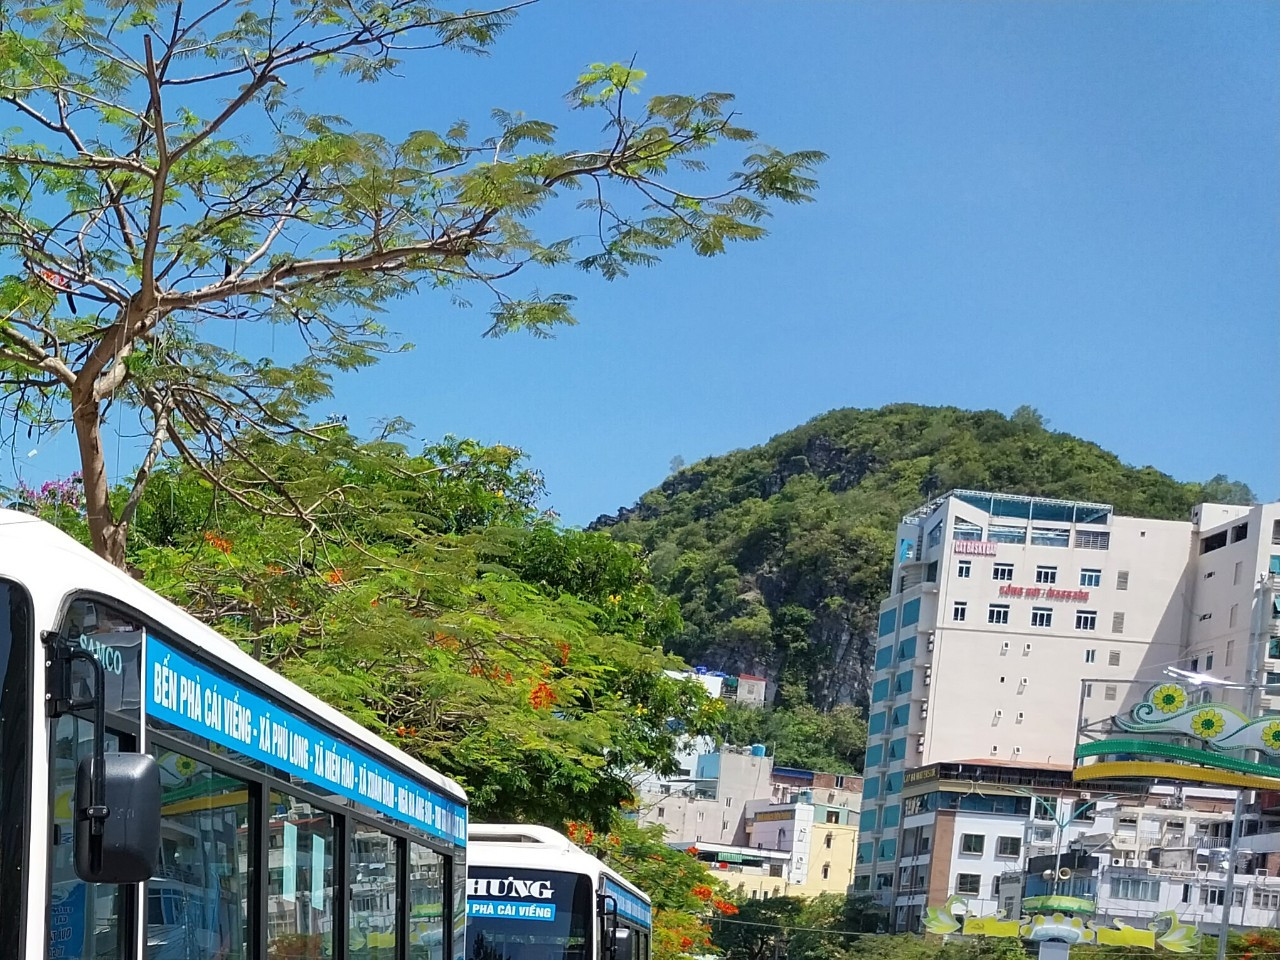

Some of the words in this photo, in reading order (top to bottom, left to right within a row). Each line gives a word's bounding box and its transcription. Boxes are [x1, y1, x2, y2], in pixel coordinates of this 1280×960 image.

[80, 633, 122, 675] SAMCO
[154, 653, 178, 712] BẾN
[180, 674, 202, 723] PHÀ
[204, 684, 222, 732] CÁI
[289, 730, 309, 771] LONG
[467, 876, 555, 899] HƯNG
